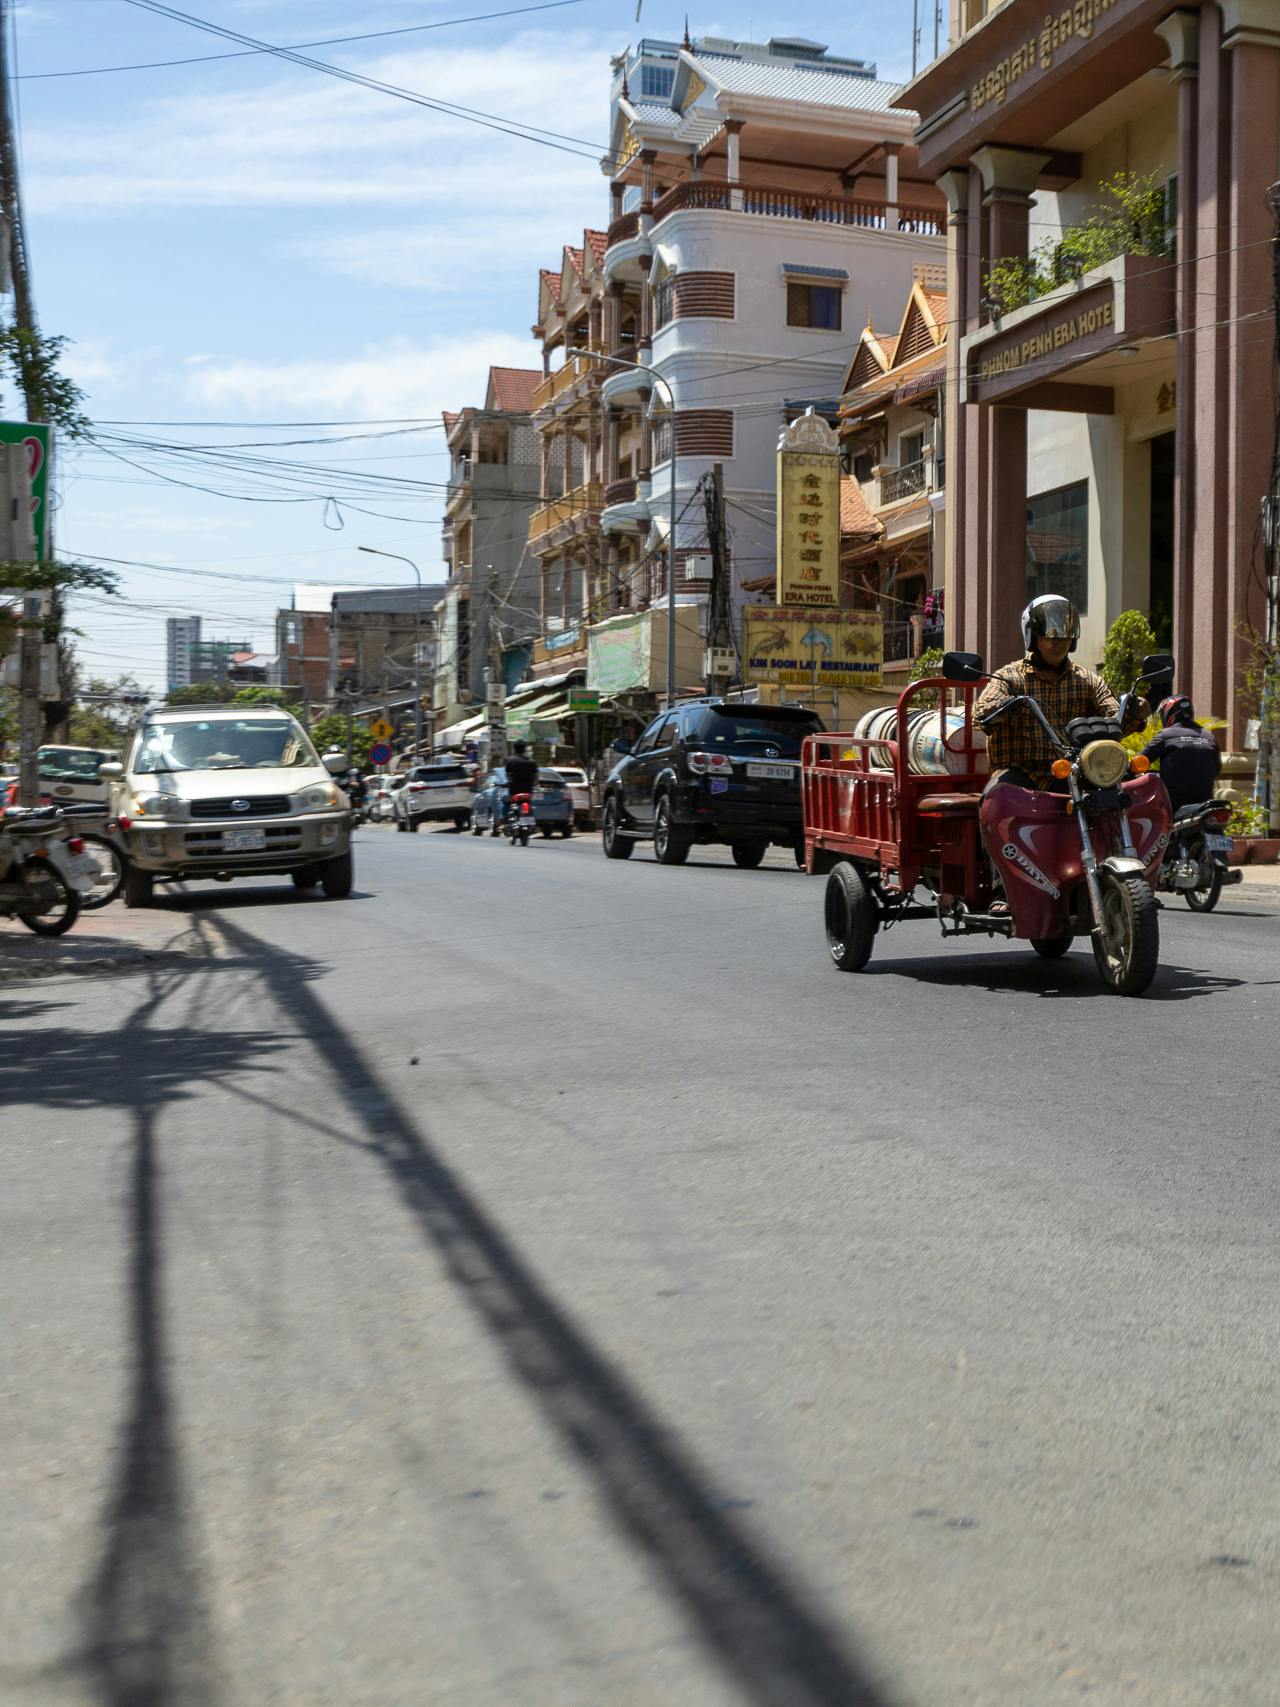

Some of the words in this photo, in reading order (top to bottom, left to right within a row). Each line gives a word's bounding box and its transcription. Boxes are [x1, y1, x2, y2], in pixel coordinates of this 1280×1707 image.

[981, 344, 1020, 381] PHNOM
[1022, 328, 1053, 363] PENH
[1054, 319, 1078, 348] ERA
[790, 584, 813, 592] PHNOM
[785, 592, 804, 602] ERA
[806, 593, 836, 603] HOTEL
[750, 658, 767, 668] KIM
[820, 661, 880, 672] RESTAURANT
[1016, 855, 1061, 900] DAYUN
